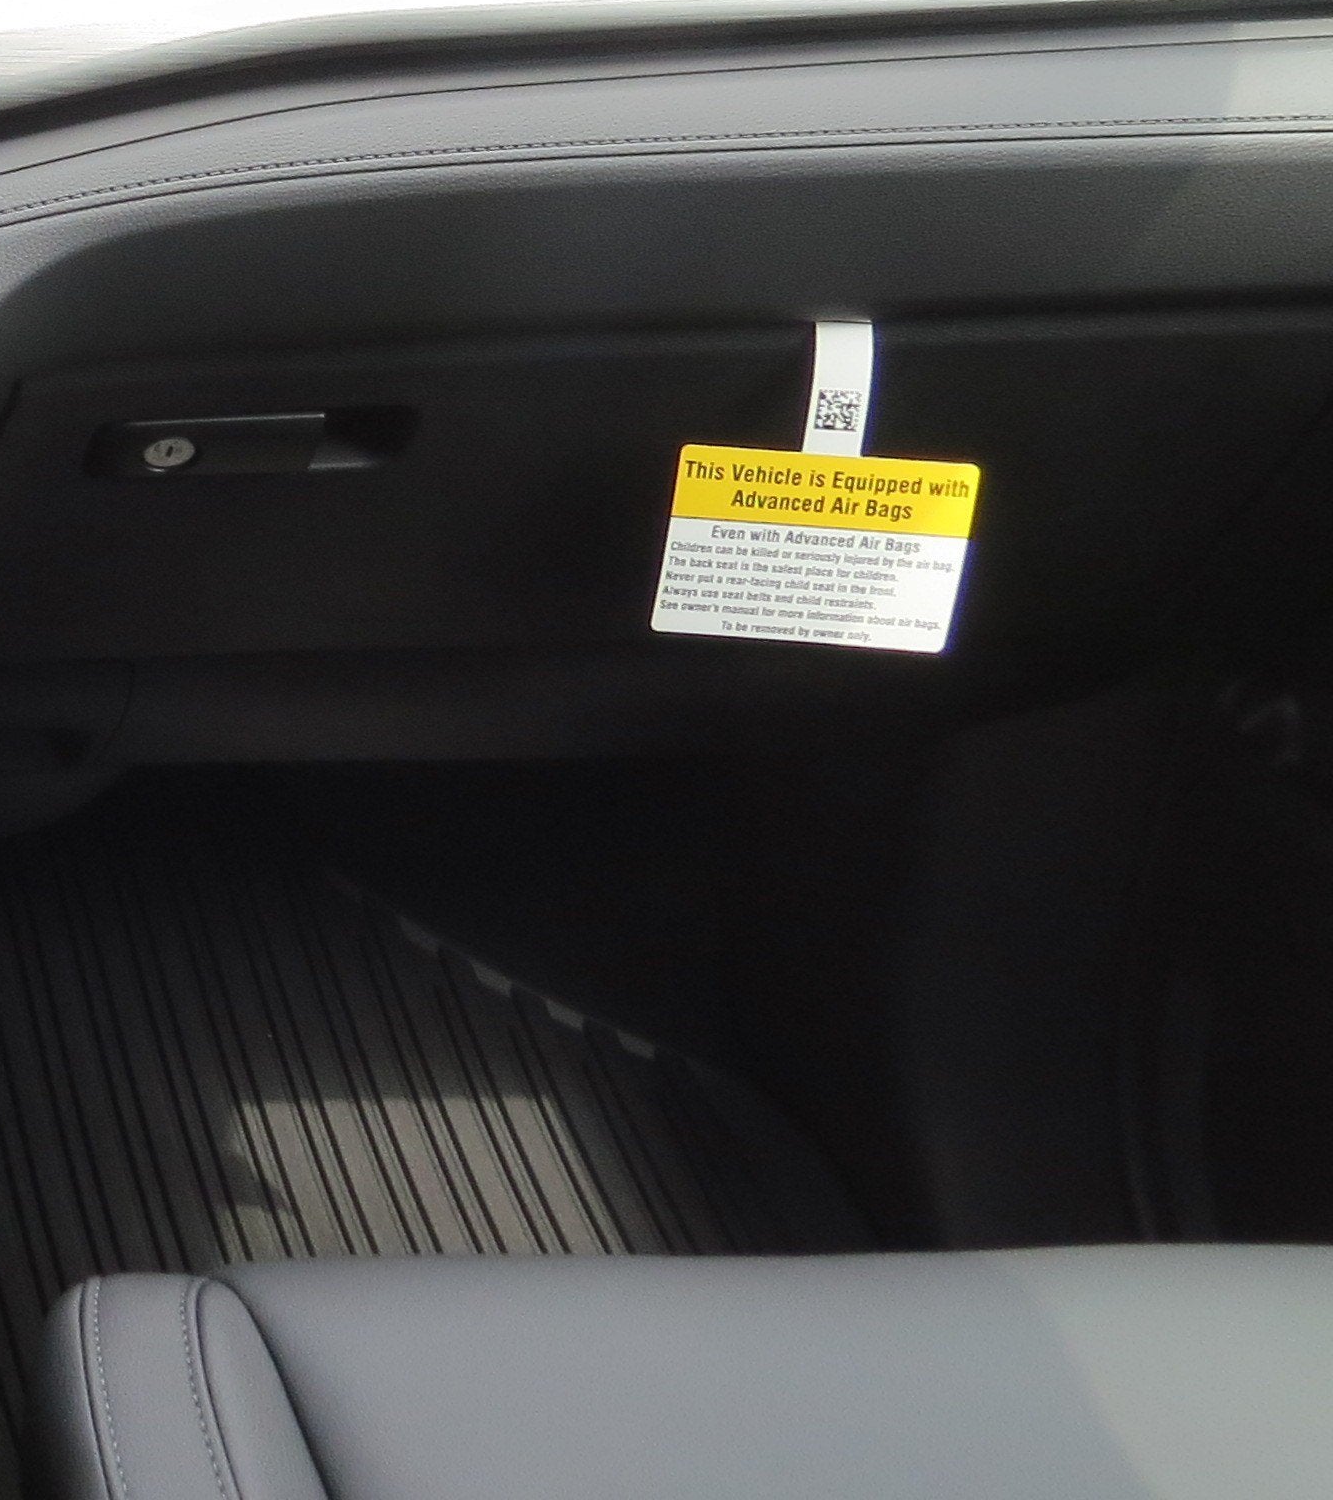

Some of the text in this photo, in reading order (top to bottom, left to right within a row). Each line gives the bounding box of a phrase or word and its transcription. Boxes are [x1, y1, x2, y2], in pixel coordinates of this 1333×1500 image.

[685, 459, 970, 498] This Vehicle is Equipped with
[730, 489, 914, 522] Advanced Air Bags
[711, 524, 922, 555] Even with Advanced Air Bags
[669, 556, 687, 567] The
[689, 557, 714, 569] back
[716, 560, 739, 570] seat
[740, 561, 750, 571] is
[752, 562, 769, 573] the
[804, 566, 834, 578] place
[836, 568, 851, 578] for
[670, 541, 713, 554] Children
[715, 546, 734, 555] can
[736, 545, 749, 556] be
[750, 547, 780, 558] killed
[795, 551, 842, 565] seriously
[843, 554, 880, 566] injured
[882, 557, 895, 569] by
[896, 557, 913, 568] the
[916, 560, 931, 570] air
[662, 585, 698, 598] Always
[701, 589, 719, 599] use
[721, 590, 745, 601] seat
[747, 591, 773, 602] belts
[774, 593, 793, 604] and
[795, 595, 822, 606] child
[665, 570, 695, 582] Never
[697, 574, 715, 585] put
[717, 575, 723, 584] a
[784, 579, 811, 591] child
[813, 582, 836, 592] seat
[837, 583, 848, 593] in
[850, 584, 867, 595] the
[659, 599, 679, 610] See
[681, 602, 720, 613] owner's
[722, 604, 760, 616] manual
[761, 606, 776, 617] for
[777, 609, 805, 619] more
[806, 610, 864, 623] information
[867, 615, 896, 626] about
[898, 617, 913, 627] air
[721, 620, 733, 630] To
[735, 621, 749, 632] be
[750, 623, 797, 636] removed
[798, 626, 810, 638] by
[812, 629, 845, 639] owner
